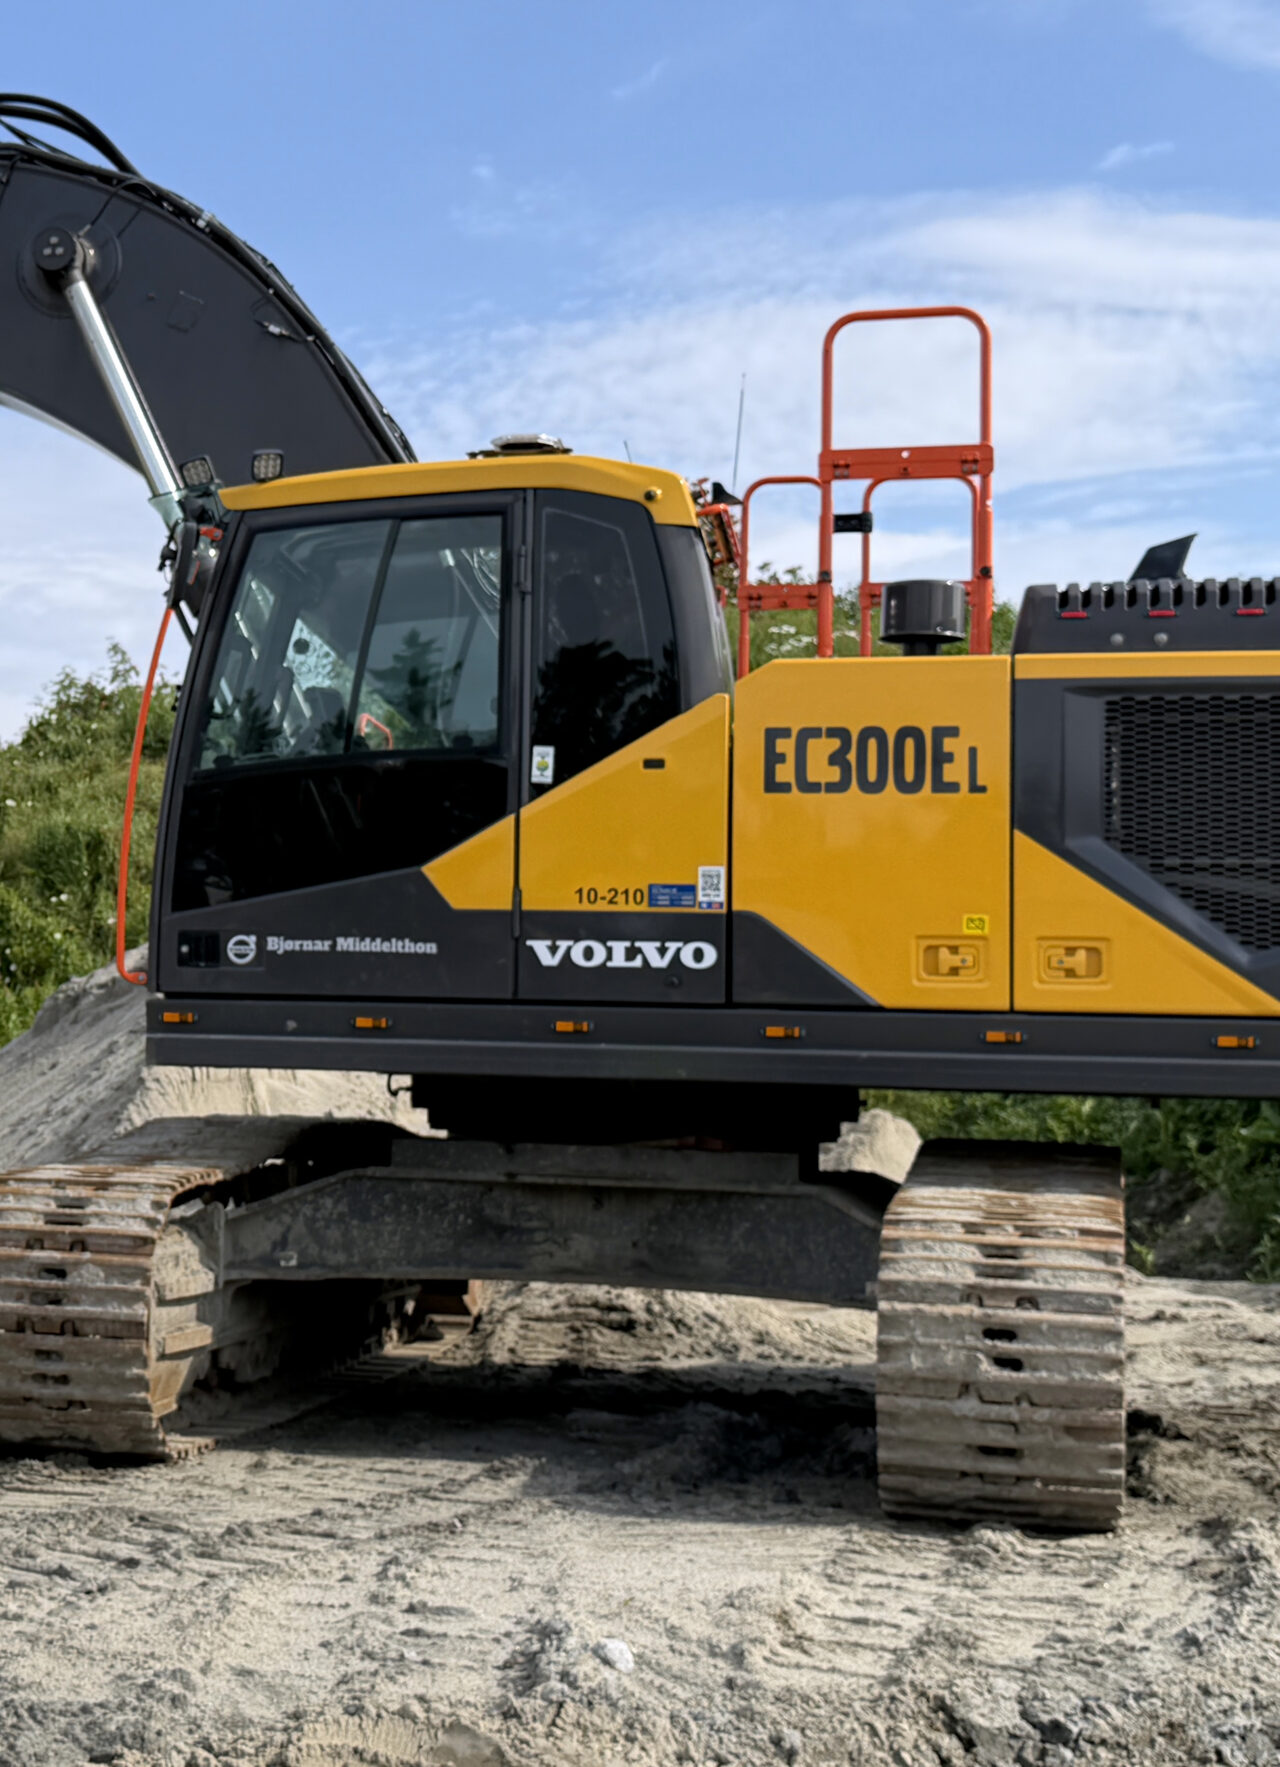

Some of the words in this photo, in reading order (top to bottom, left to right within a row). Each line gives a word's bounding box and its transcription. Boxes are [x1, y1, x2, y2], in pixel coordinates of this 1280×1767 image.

[574, 887, 645, 905] 10-210
[266, 936, 332, 955] Bjørnar
[336, 936, 438, 955] Middelthon
[525, 939, 718, 970] VOLVO
